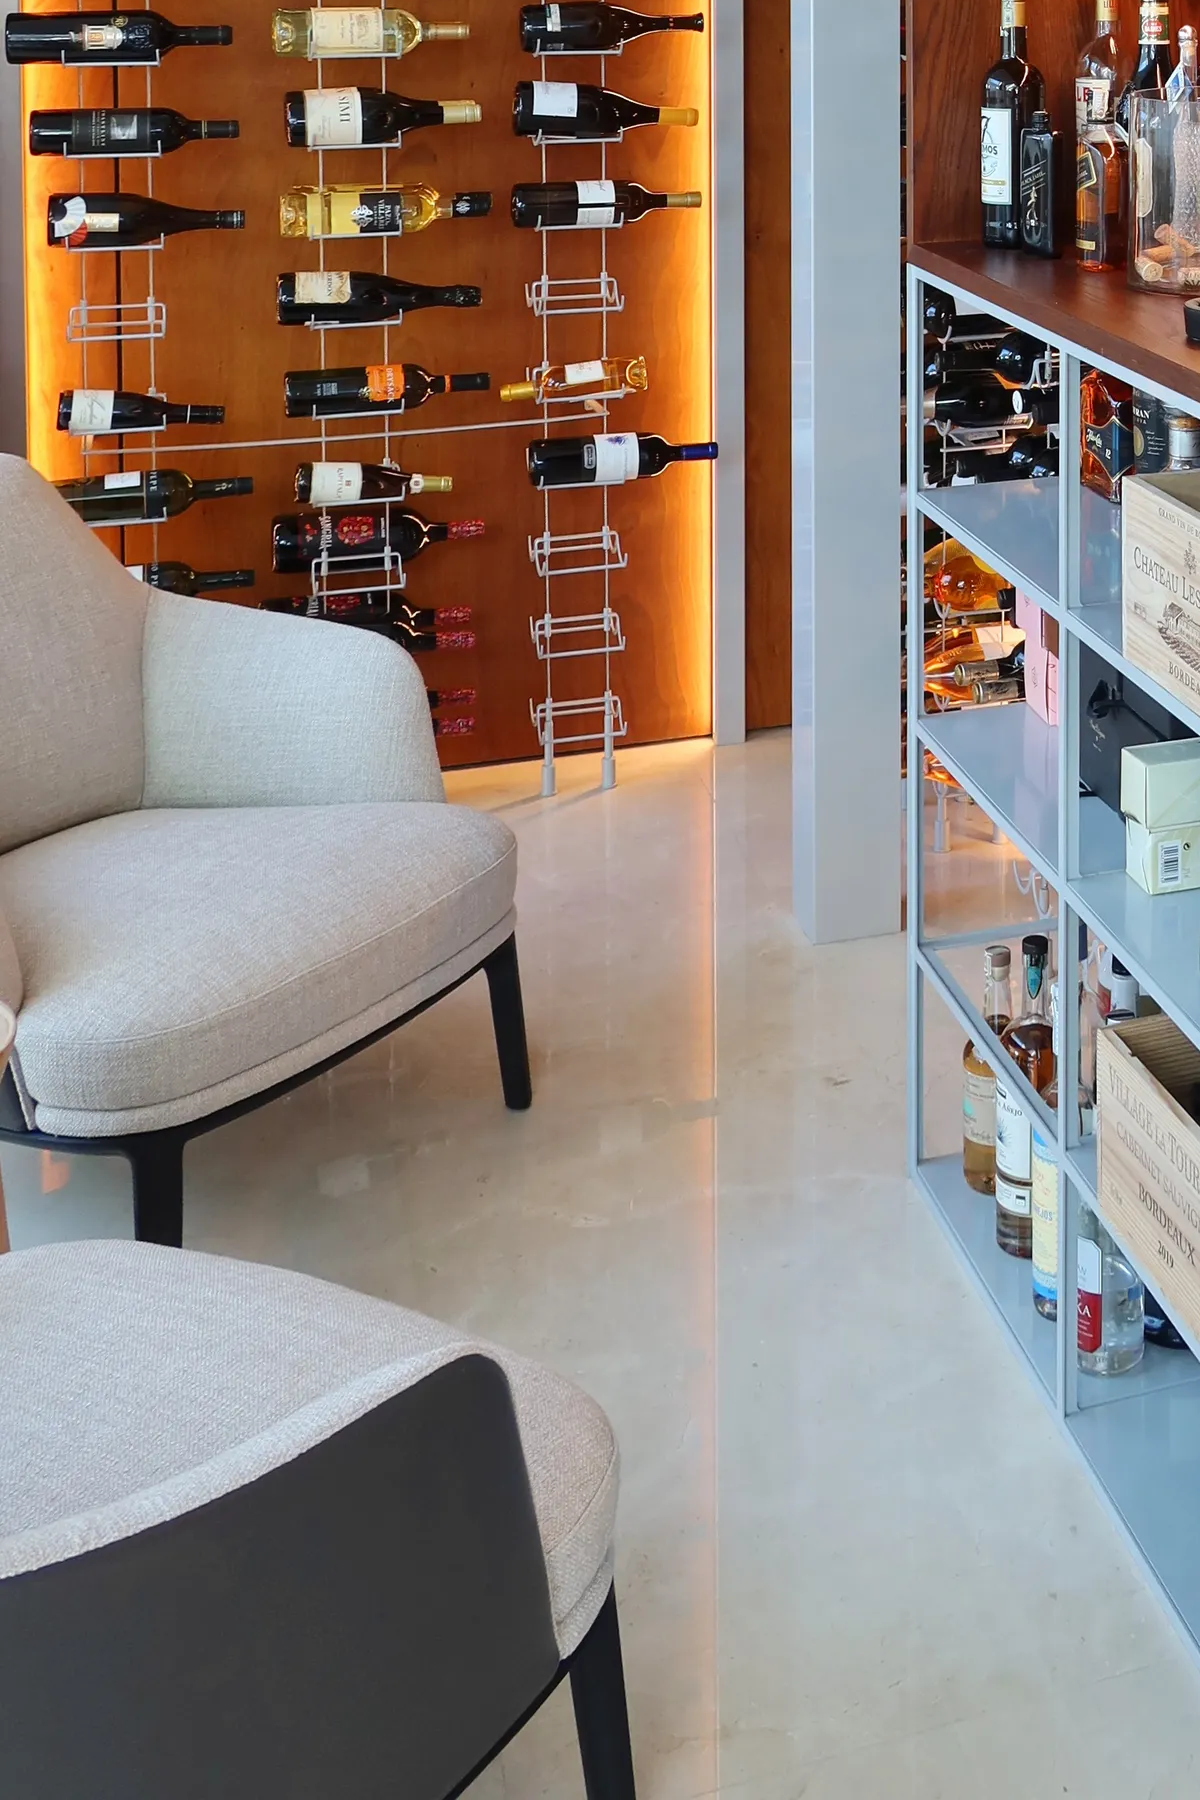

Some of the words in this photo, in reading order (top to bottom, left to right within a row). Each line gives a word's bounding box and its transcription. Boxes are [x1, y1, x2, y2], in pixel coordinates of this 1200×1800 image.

[339, 95, 351, 123] SIMI
[386, 367, 395, 403] DRYSACK
[1158, 506, 1176, 525] GRAND
[1176, 515, 1186, 531] VIN
[1186, 521, 1195, 536] DE
[1133, 546, 1180, 595] CHATEAU
[1108, 1062, 1154, 1133] VILLAGE
[1116, 1120, 1162, 1186] CABERNET
[1137, 1182, 1197, 1268] BORDEAUX
[1156, 1239, 1175, 1270] 2019
